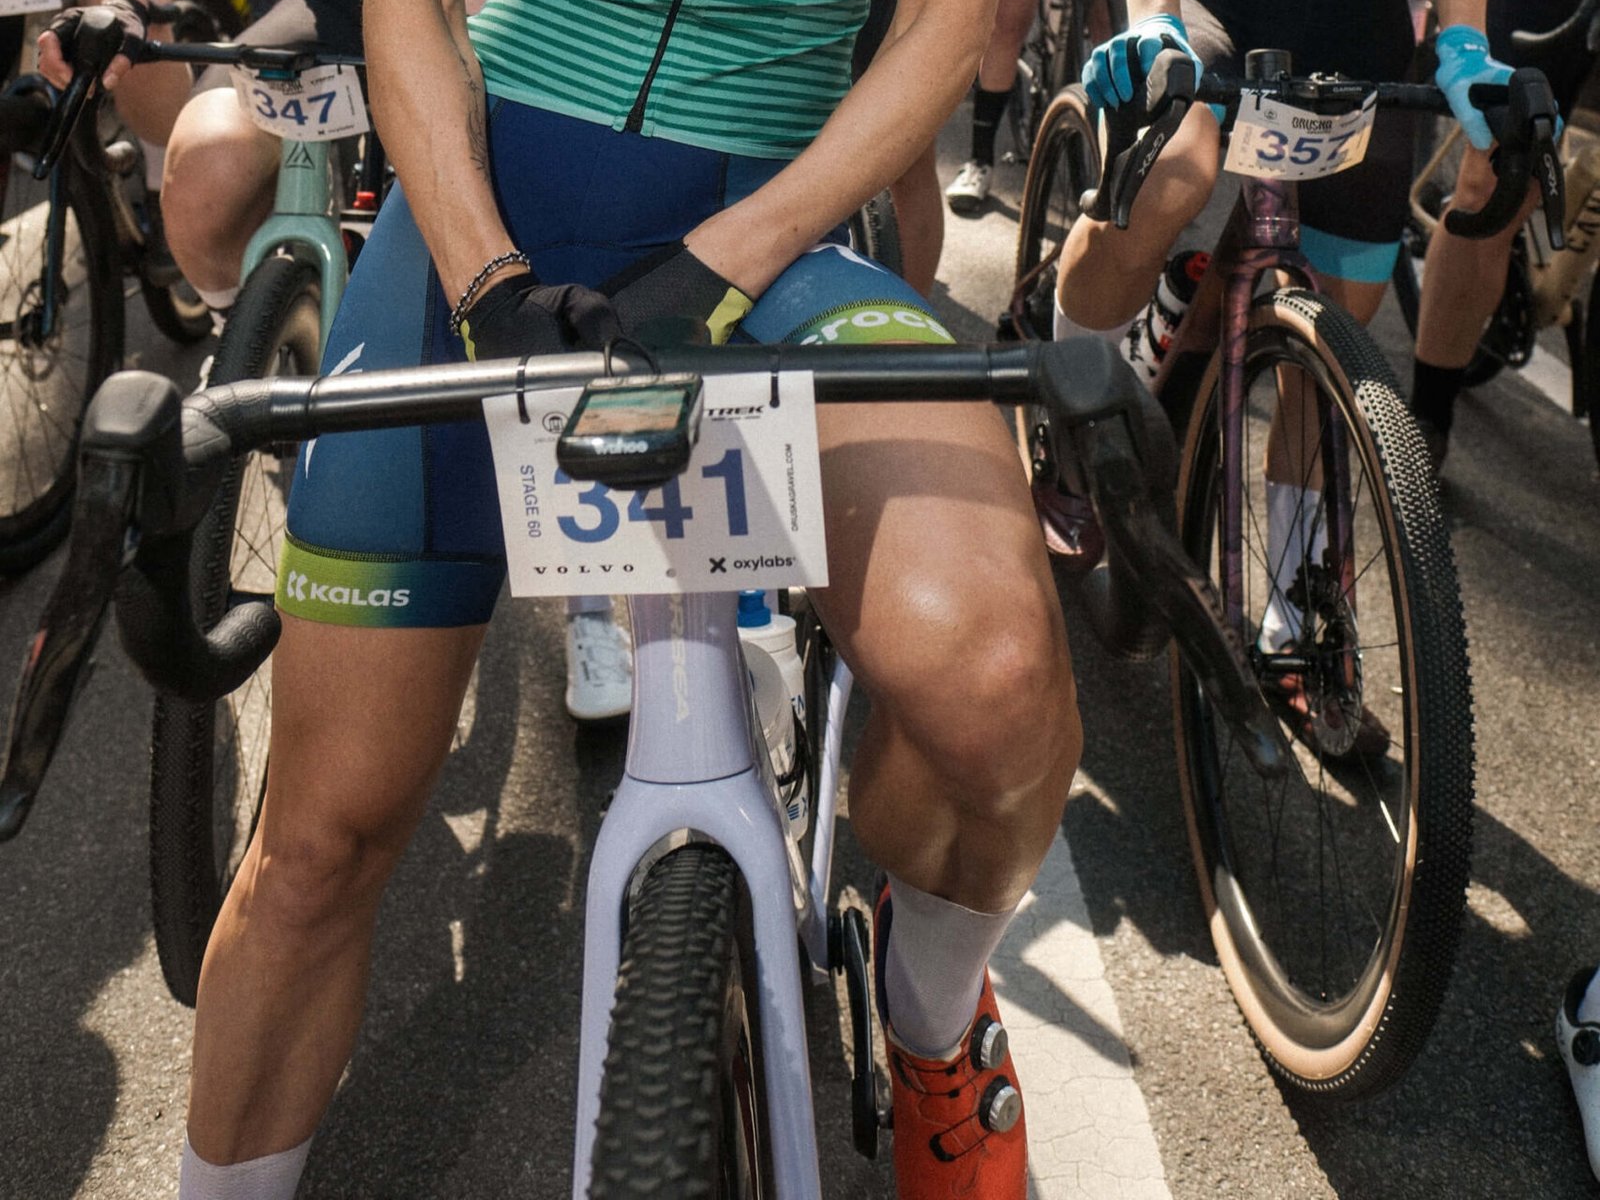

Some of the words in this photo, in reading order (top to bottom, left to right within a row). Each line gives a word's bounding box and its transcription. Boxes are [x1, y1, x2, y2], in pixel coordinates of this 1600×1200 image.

[252, 88, 337, 125] 347
[1255, 129, 1356, 165] 357
[703, 404, 765, 417] TREK
[520, 464, 540, 517] STAGE
[554, 448, 749, 543] 341
[785, 443, 799, 532] DRUSKAGRAVEL.COM
[527, 520, 542, 539] 60
[533, 563, 635, 575] VOLVO
[733, 555, 795, 572] oxylabs
[669, 593, 690, 721] RBEA
